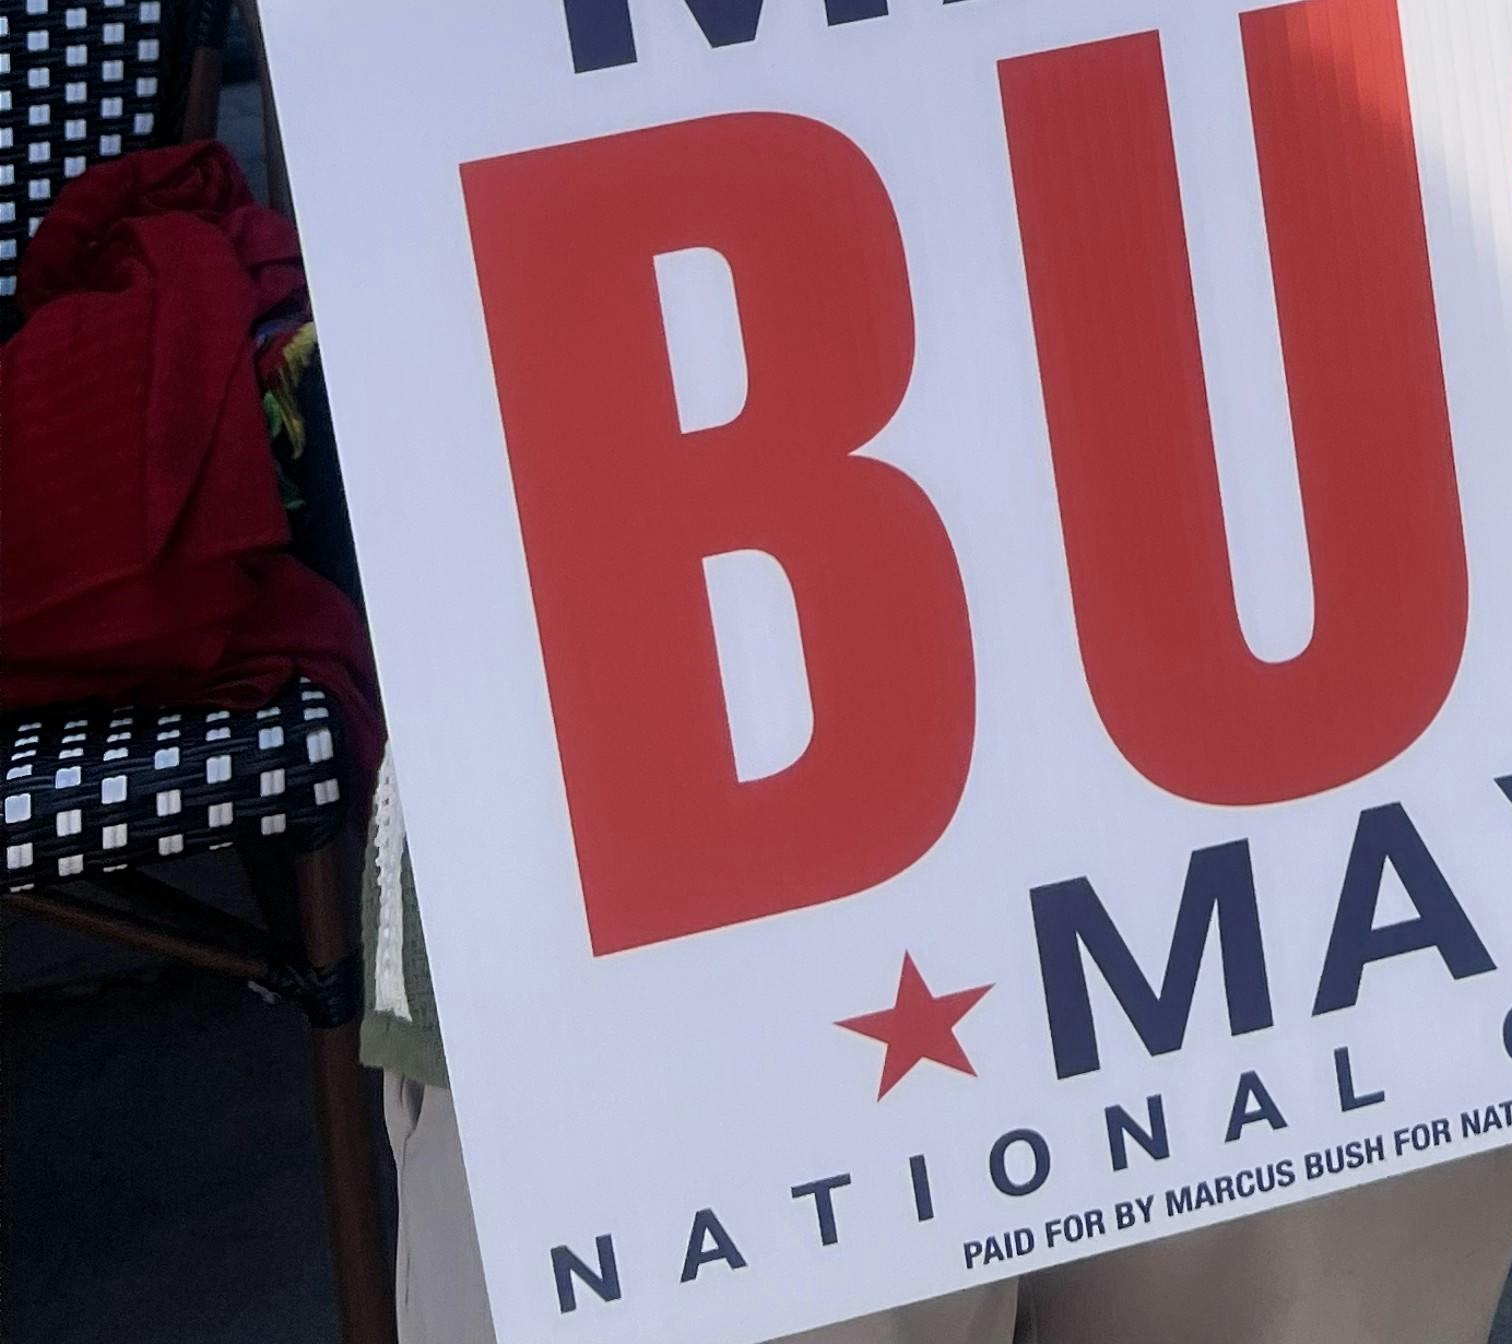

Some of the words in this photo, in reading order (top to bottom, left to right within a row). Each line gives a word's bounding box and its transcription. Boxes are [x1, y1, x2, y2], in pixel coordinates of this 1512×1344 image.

[550, 1047, 1386, 1314] NATIONAL
[963, 1227, 1035, 1269] PAID
[1045, 1209, 1106, 1248] FOR
[1114, 1195, 1155, 1230] BY
[1165, 1160, 1296, 1217] MARCUS
[1304, 1135, 1385, 1180] BUSH
[1394, 1118, 1452, 1156] FOR
